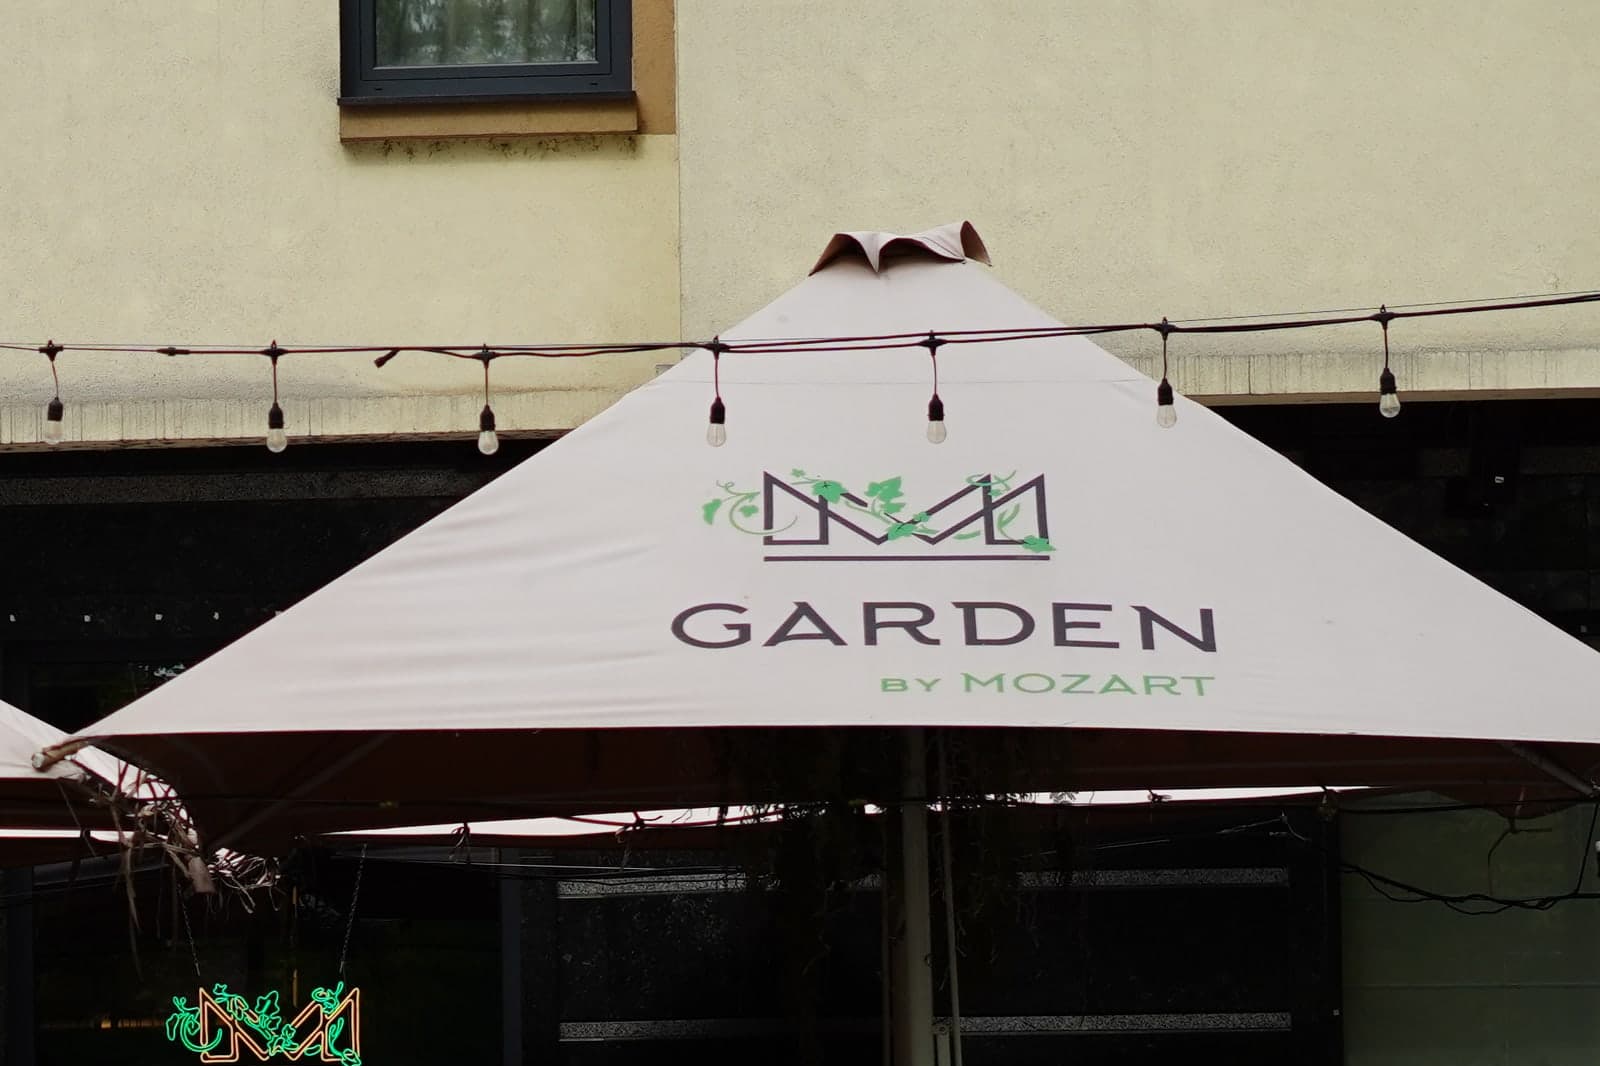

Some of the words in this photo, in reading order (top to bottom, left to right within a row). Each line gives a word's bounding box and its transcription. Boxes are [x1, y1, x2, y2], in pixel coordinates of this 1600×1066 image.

[671, 601, 1217, 653] GARDEN
[880, 678, 942, 693] BY
[961, 672, 1216, 696] MOZART
